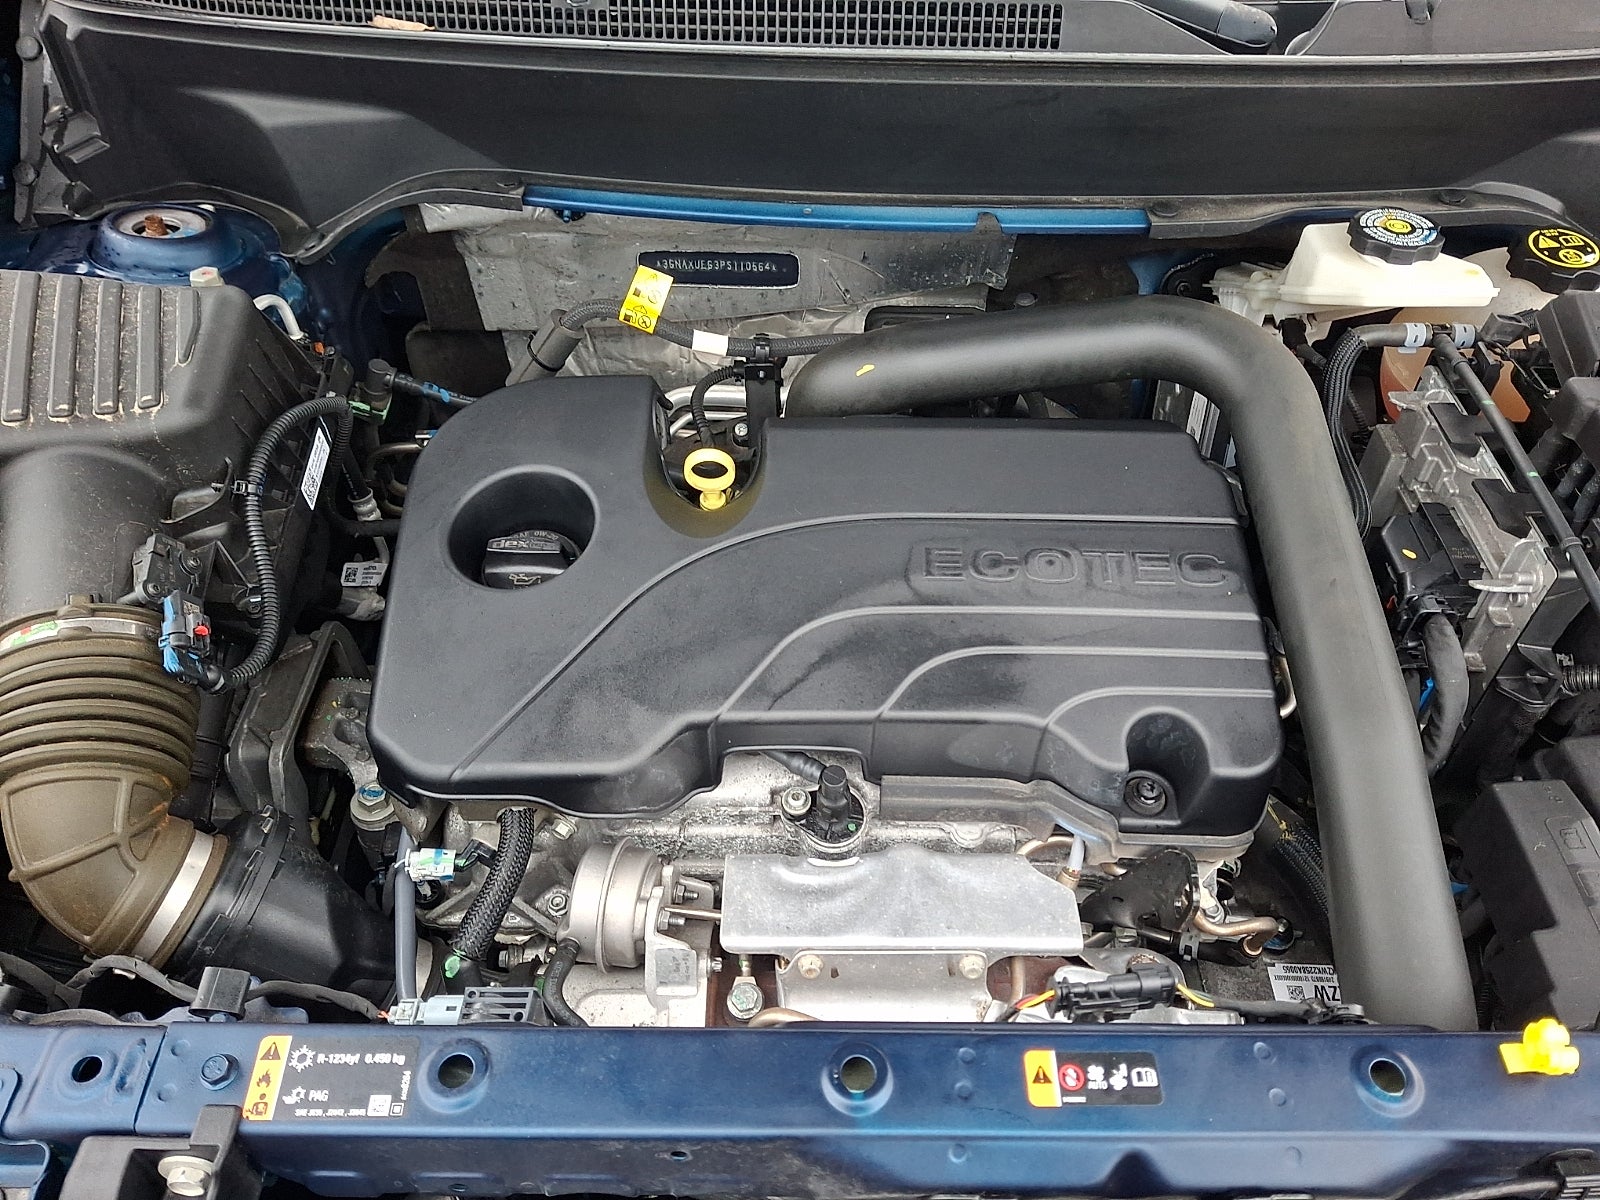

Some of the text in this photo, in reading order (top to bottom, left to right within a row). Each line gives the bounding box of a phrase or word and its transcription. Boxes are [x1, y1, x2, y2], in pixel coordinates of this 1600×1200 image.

[923, 548, 1226, 586] ECOTEC
[317, 1053, 360, 1065] R-1234yf
[393, 1054, 405, 1065] kg
[309, 1090, 329, 1102] PAG
